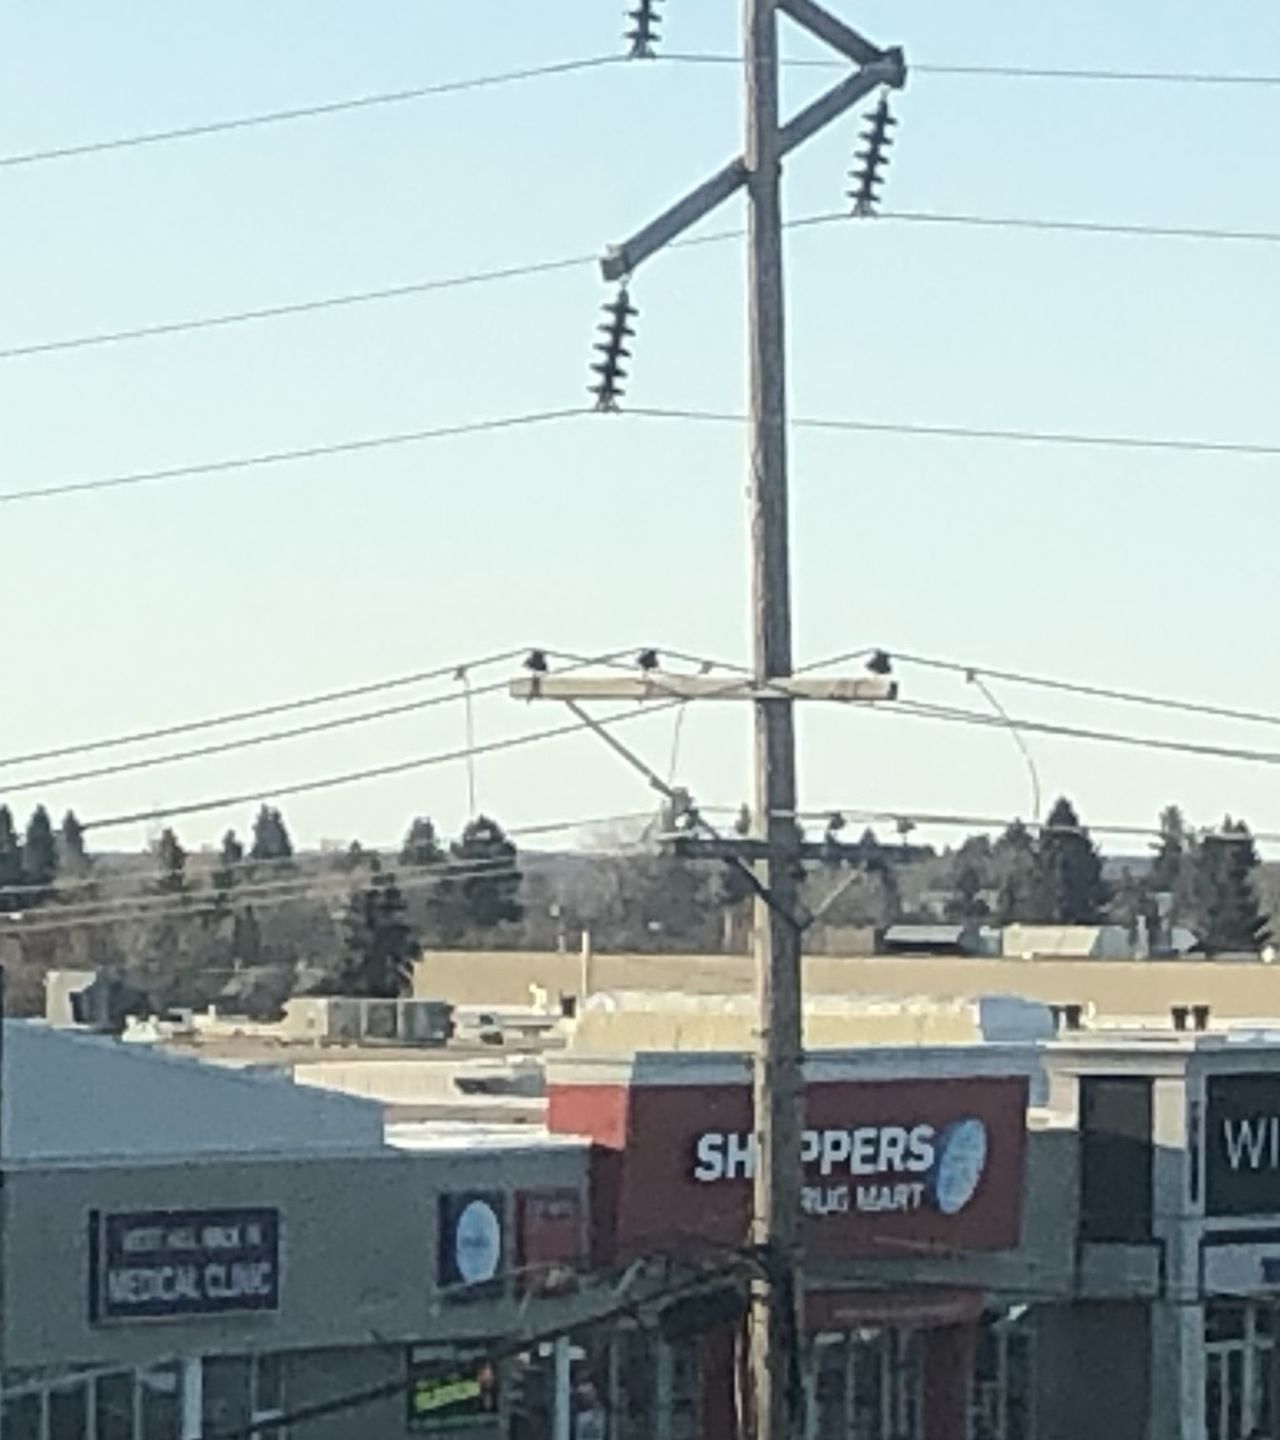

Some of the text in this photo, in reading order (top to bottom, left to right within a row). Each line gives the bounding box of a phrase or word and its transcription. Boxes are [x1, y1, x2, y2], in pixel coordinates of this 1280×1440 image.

[693, 1124, 936, 1182] SHPPERS
[799, 1183, 924, 1214] RUG MART
[108, 1261, 273, 1303] MEDICAL CLINIC
